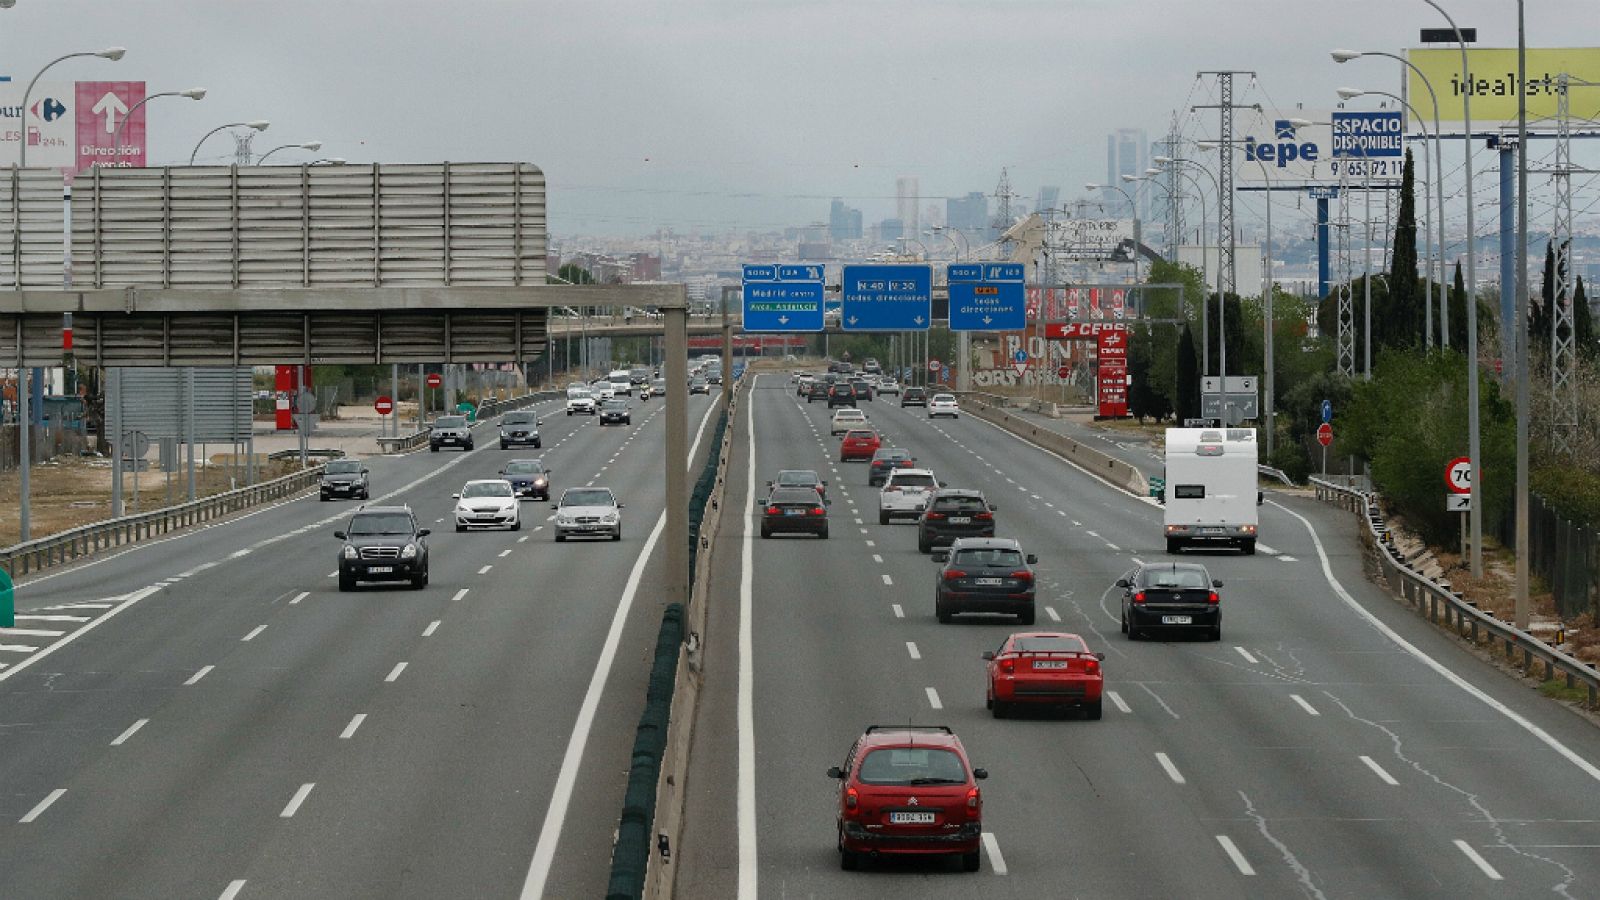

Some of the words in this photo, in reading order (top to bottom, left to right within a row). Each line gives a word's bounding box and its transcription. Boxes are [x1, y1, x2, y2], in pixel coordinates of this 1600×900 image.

[1451, 73, 1566, 96] idealst
[0, 105, 23, 118] ur
[1333, 118, 1401, 133] ESPACIO
[81, 144, 140, 155] Direción
[1334, 135, 1401, 150] DISPONIBLE
